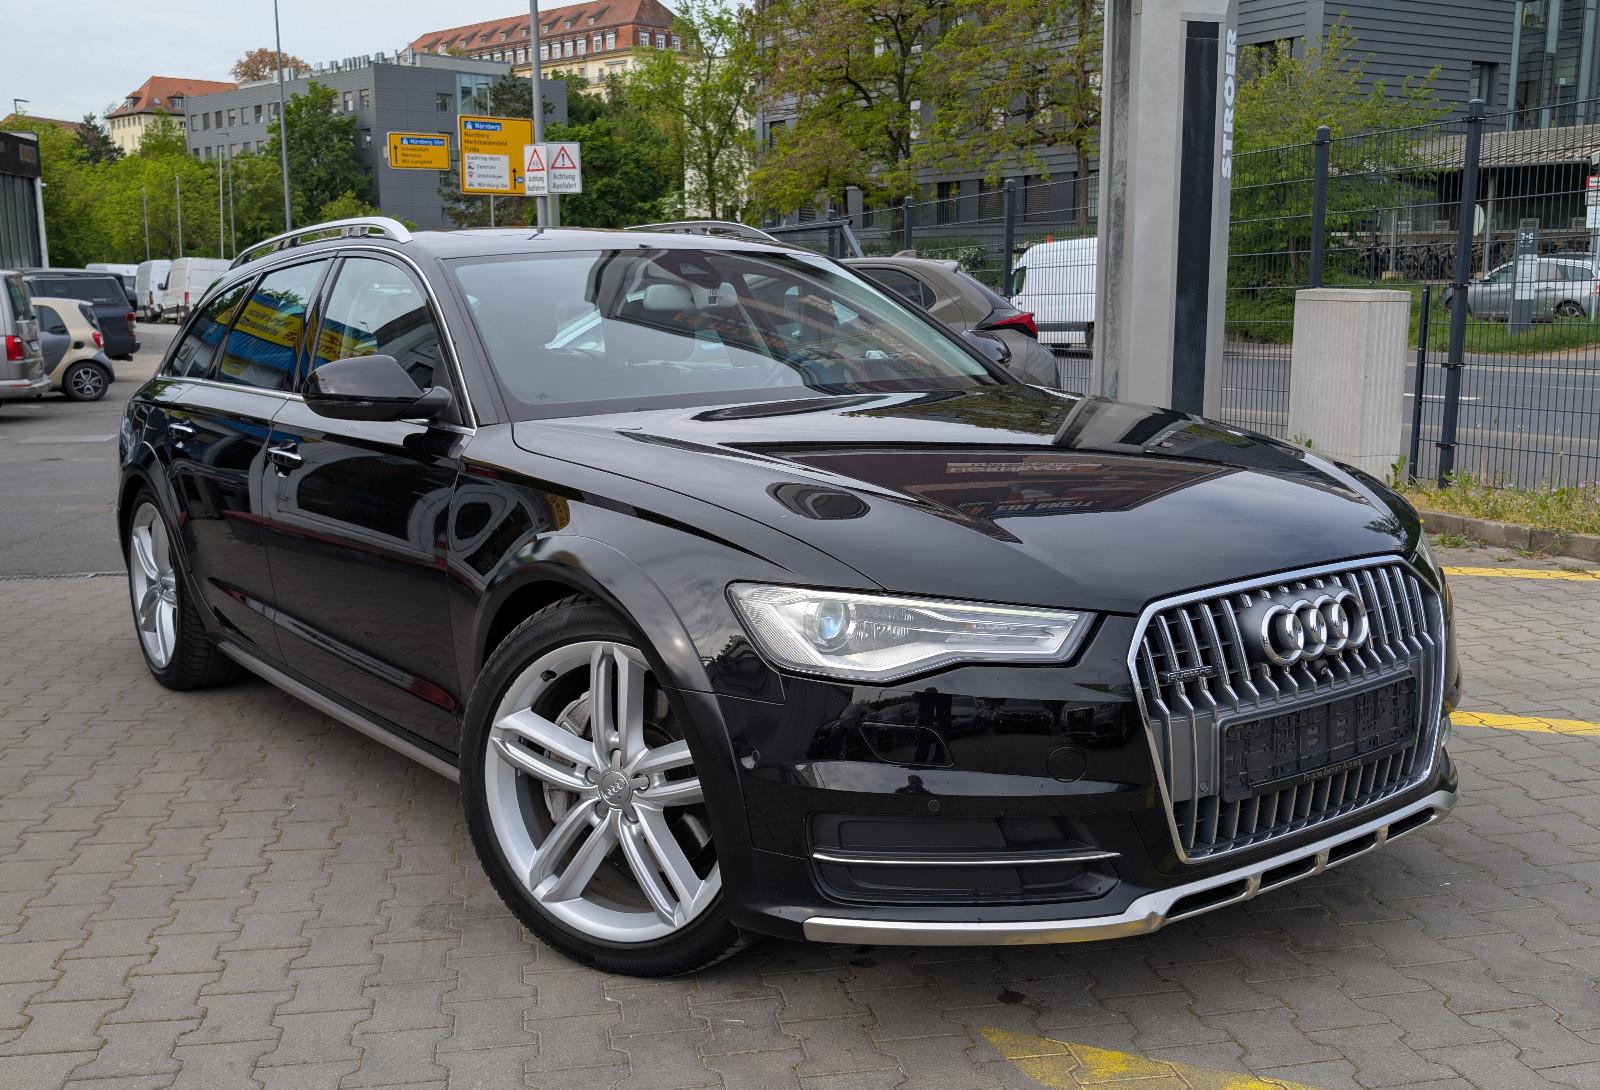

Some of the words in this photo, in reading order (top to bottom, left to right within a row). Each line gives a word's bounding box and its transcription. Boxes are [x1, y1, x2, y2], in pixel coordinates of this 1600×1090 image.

[1221, 28, 1237, 179] STRÖER
[474, 122, 501, 132] Nürnberg
[464, 131, 490, 140] Nürnberg
[410, 138, 433, 146] Nürnberg
[464, 145, 480, 153] Fulda
[528, 175, 545, 183] Achtung
[553, 172, 576, 182] Achtung
[552, 182, 577, 191] Ausfahrt
